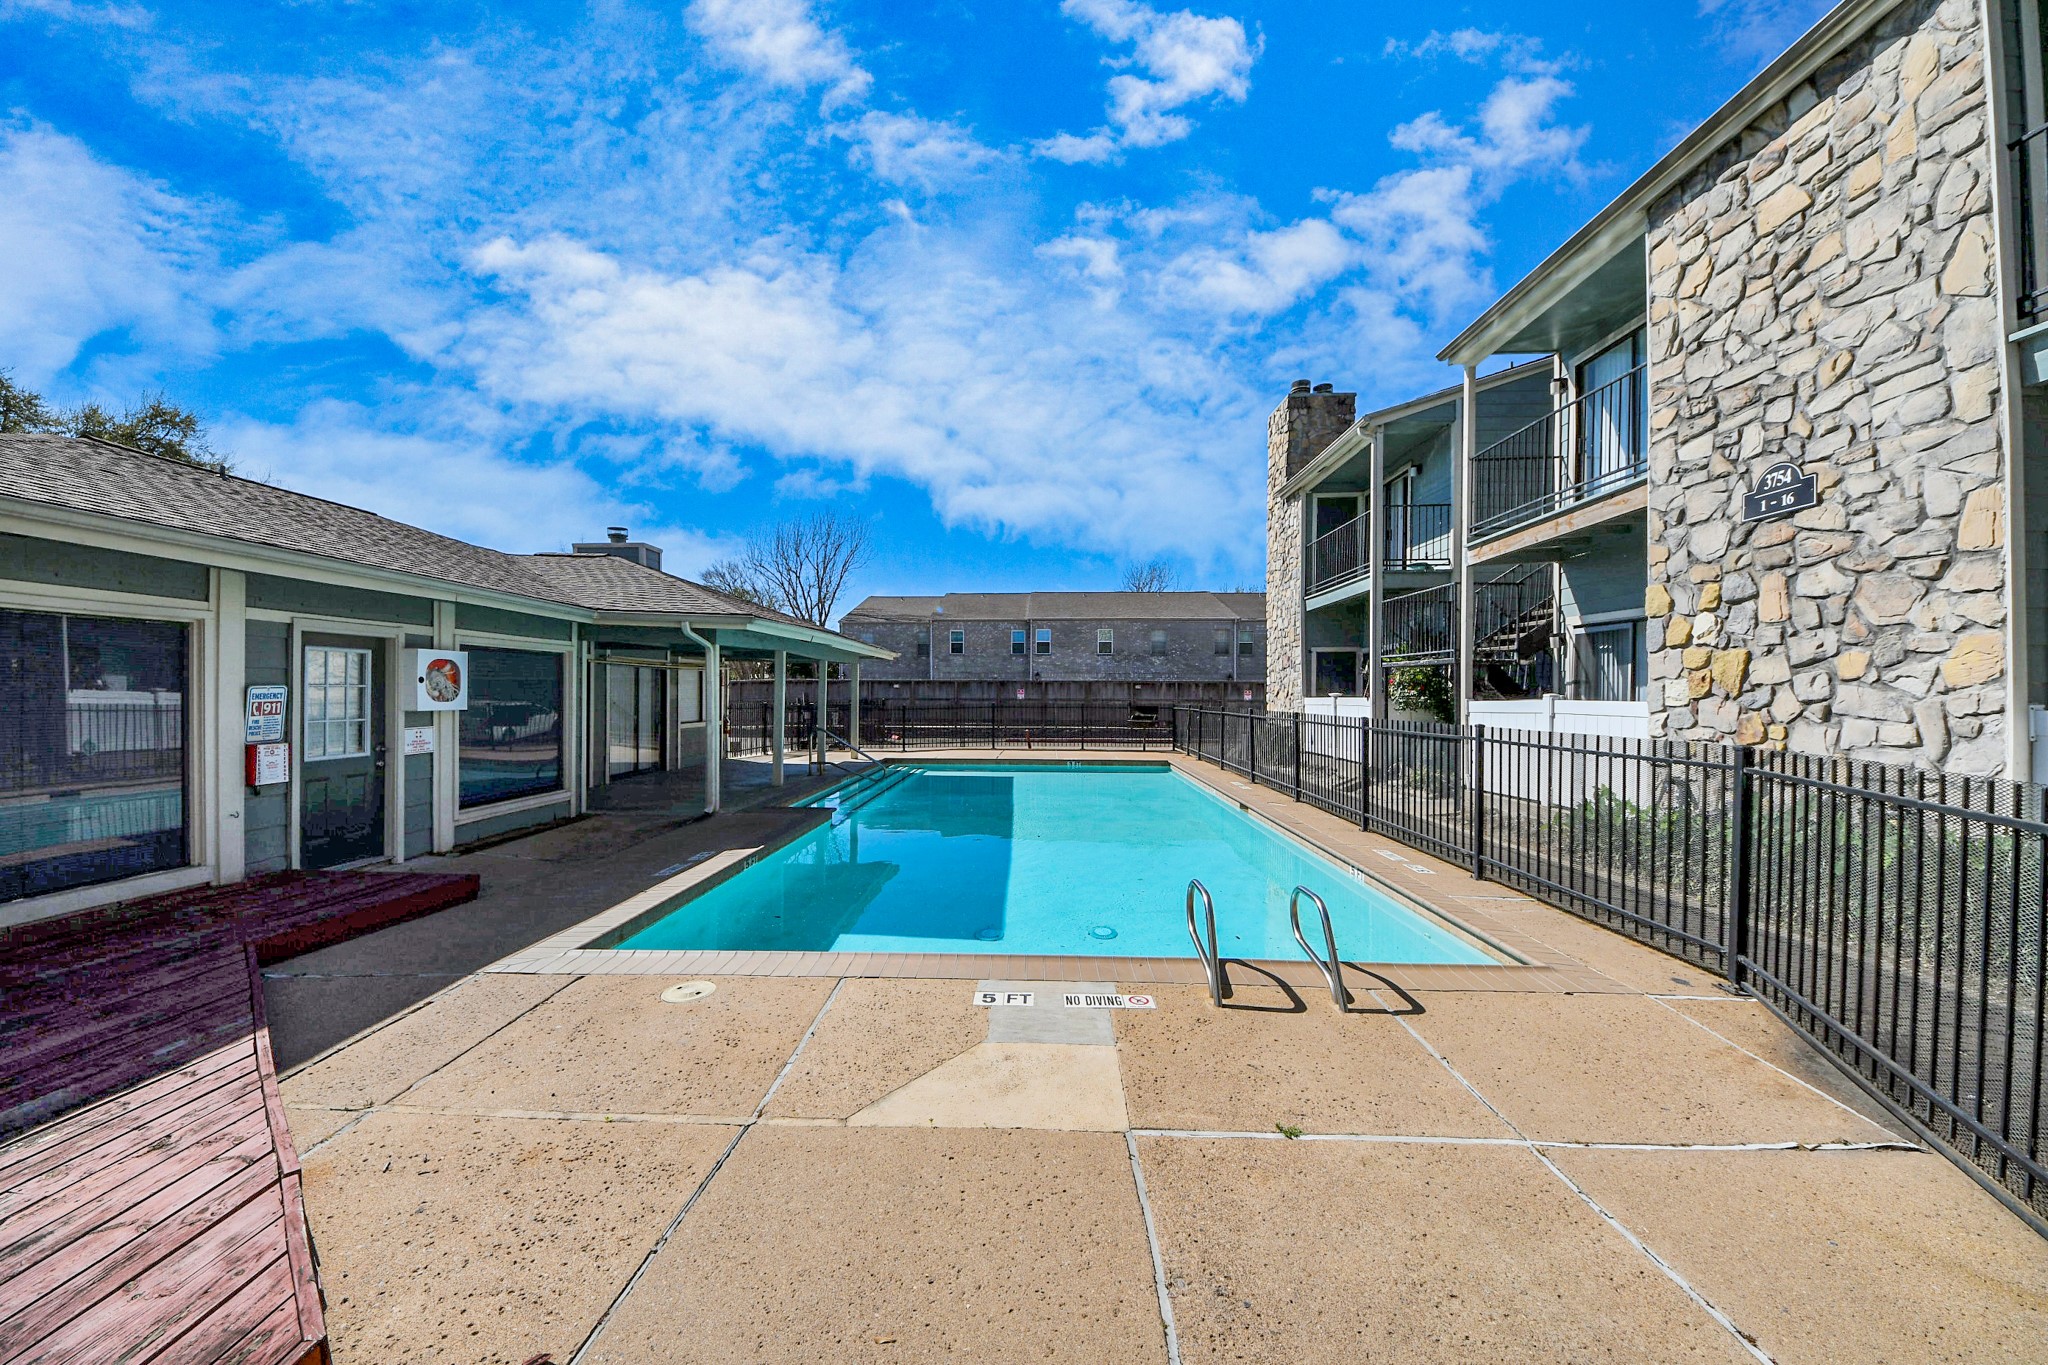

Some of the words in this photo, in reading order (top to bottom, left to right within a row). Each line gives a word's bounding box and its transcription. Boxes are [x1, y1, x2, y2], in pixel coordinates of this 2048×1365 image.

[1764, 468, 1792, 490] 3754
[1761, 500, 1766, 511] 1
[1781, 492, 1795, 507] 16
[252, 692, 284, 700] EMERGENCY
[263, 703, 281, 714] 911
[982, 993, 997, 1004] 5
[1006, 993, 1032, 1004] FT
[1065, 995, 1081, 1006] NO
[1086, 995, 1122, 1006] DIVING
